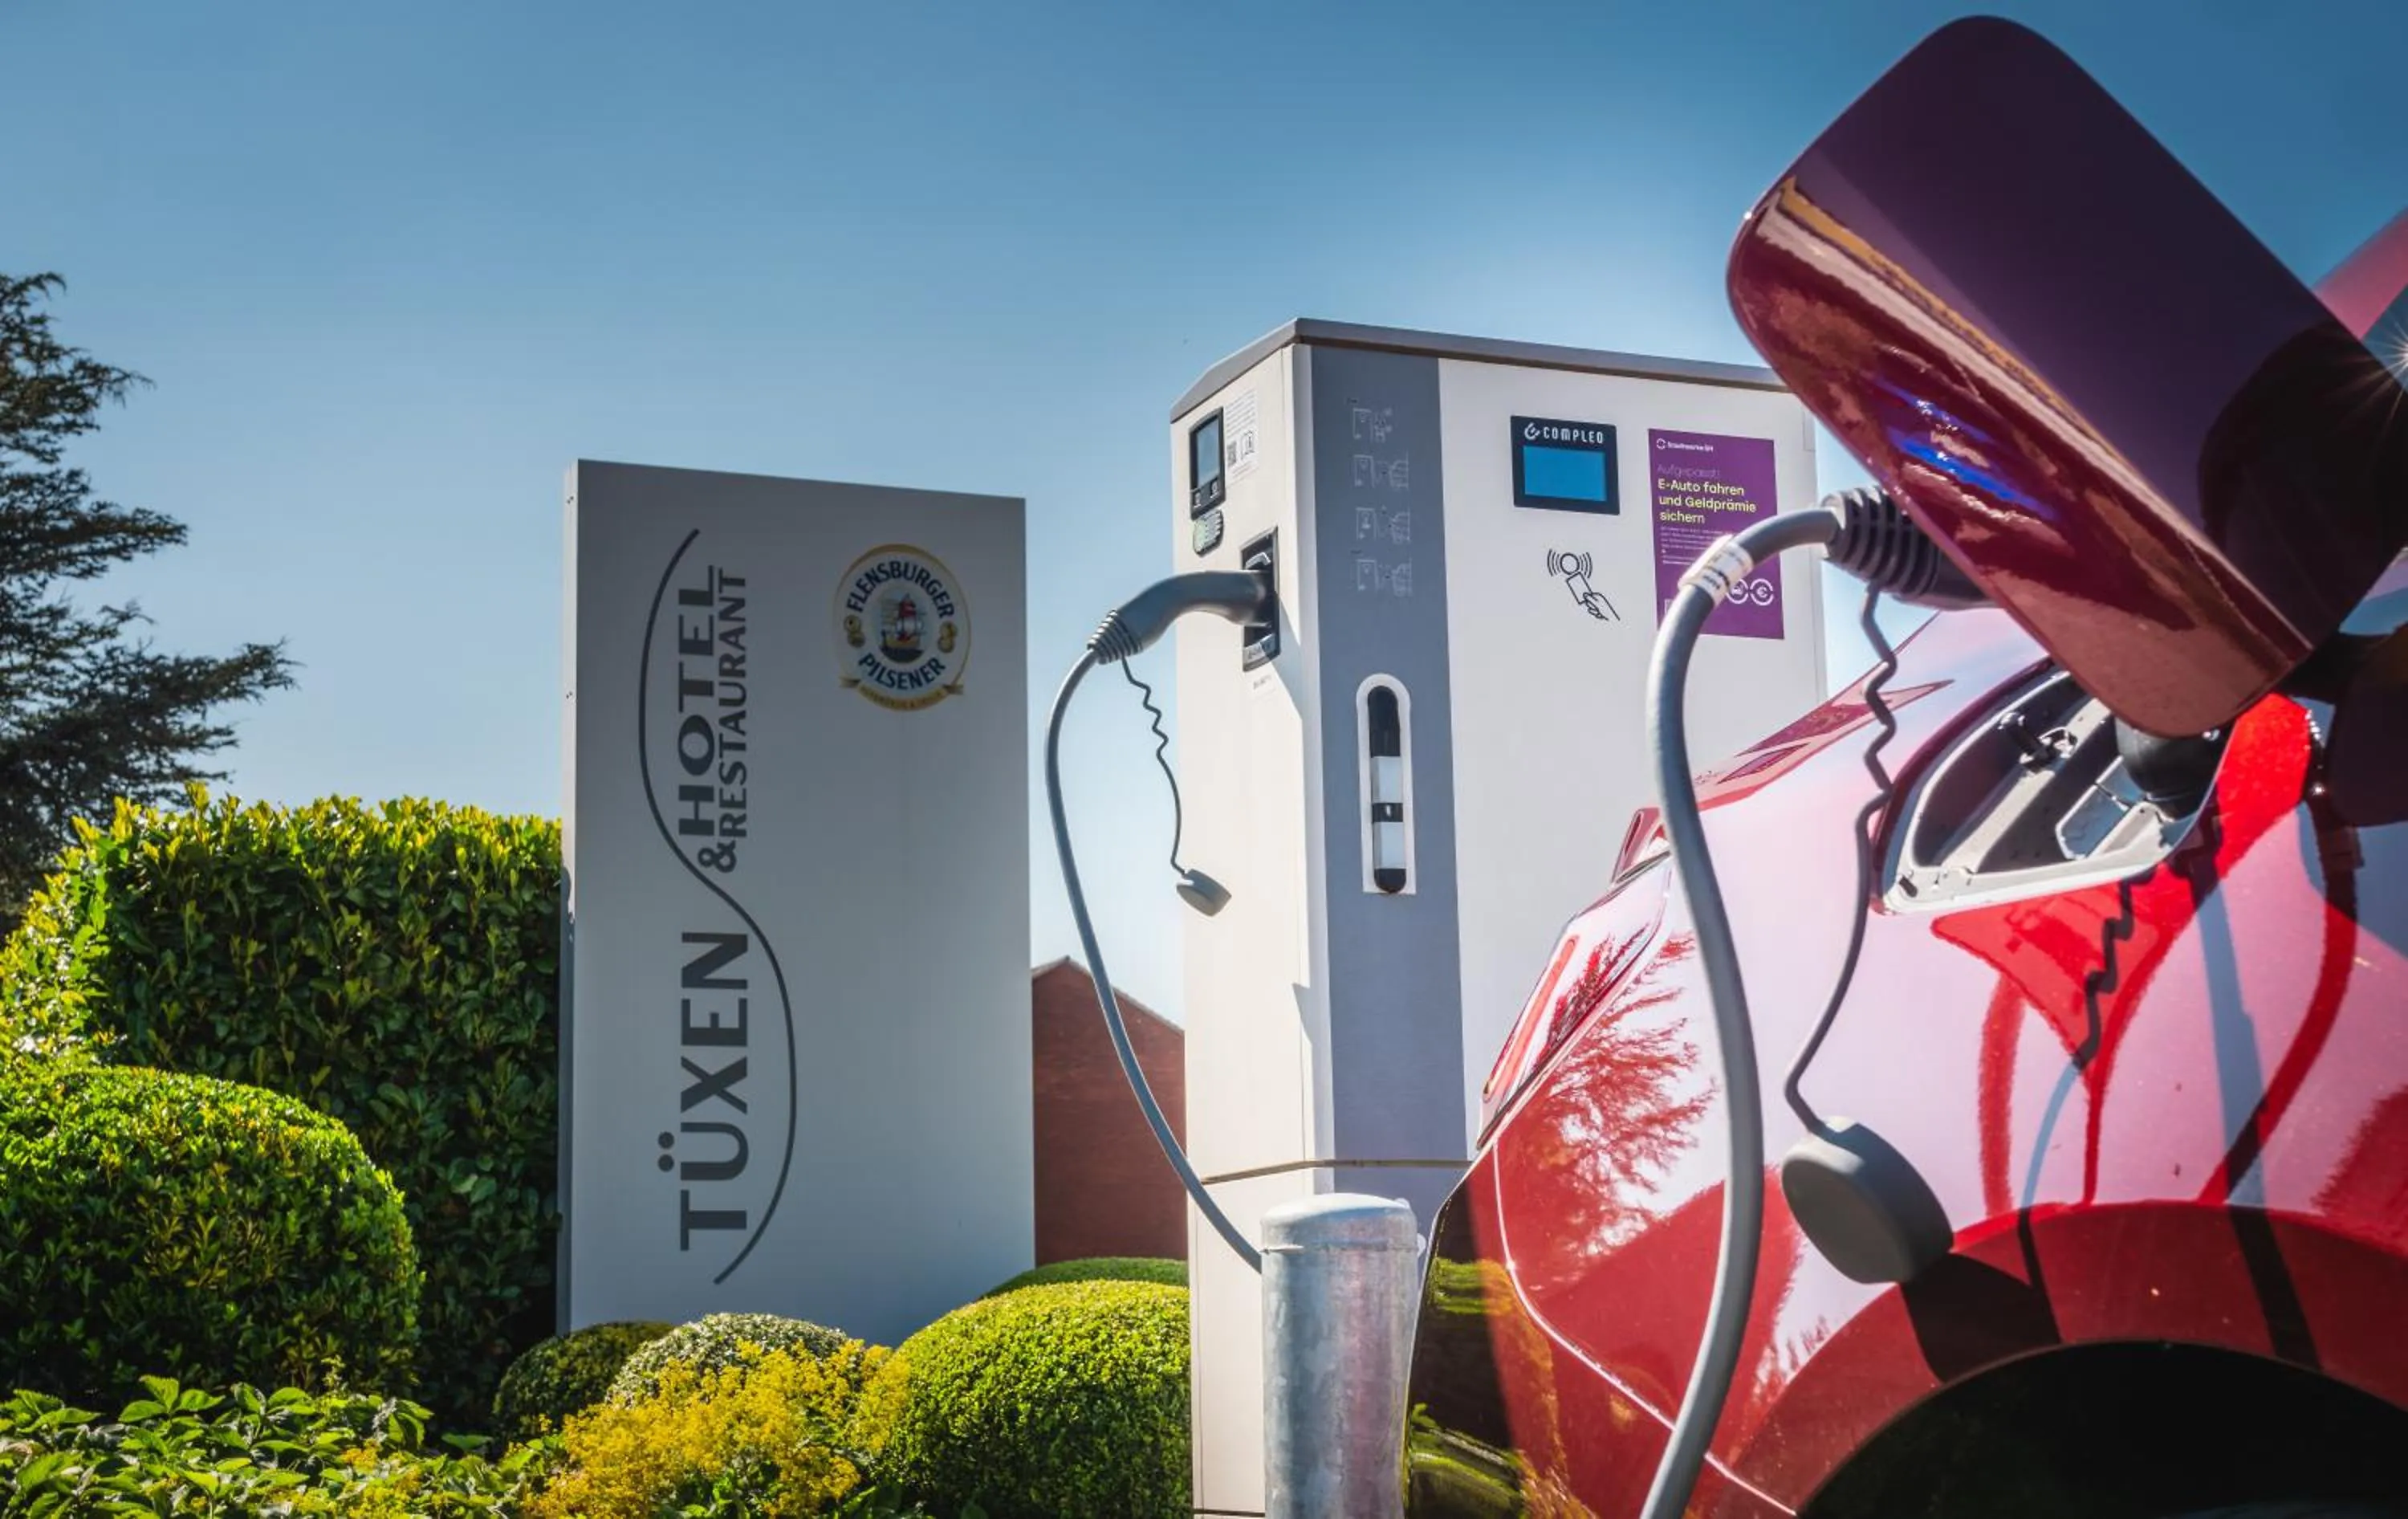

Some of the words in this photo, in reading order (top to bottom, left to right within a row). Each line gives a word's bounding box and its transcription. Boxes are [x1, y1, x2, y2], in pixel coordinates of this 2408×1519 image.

[1543, 426, 1604, 444] COMPLEO
[1658, 479, 1701, 492] E-Auto
[1703, 482, 1745, 496] fahren
[1659, 495, 1682, 507] und
[1686, 496, 1757, 513] Geldprämie
[1659, 511, 1706, 524] sichern
[846, 560, 955, 619] FLENSBURGER
[858, 652, 946, 690] PILSENER
[677, 564, 715, 836] HOTEL
[698, 840, 737, 873] &
[718, 567, 747, 838] RESTAURANT
[657, 931, 749, 1251] TÜXEN
